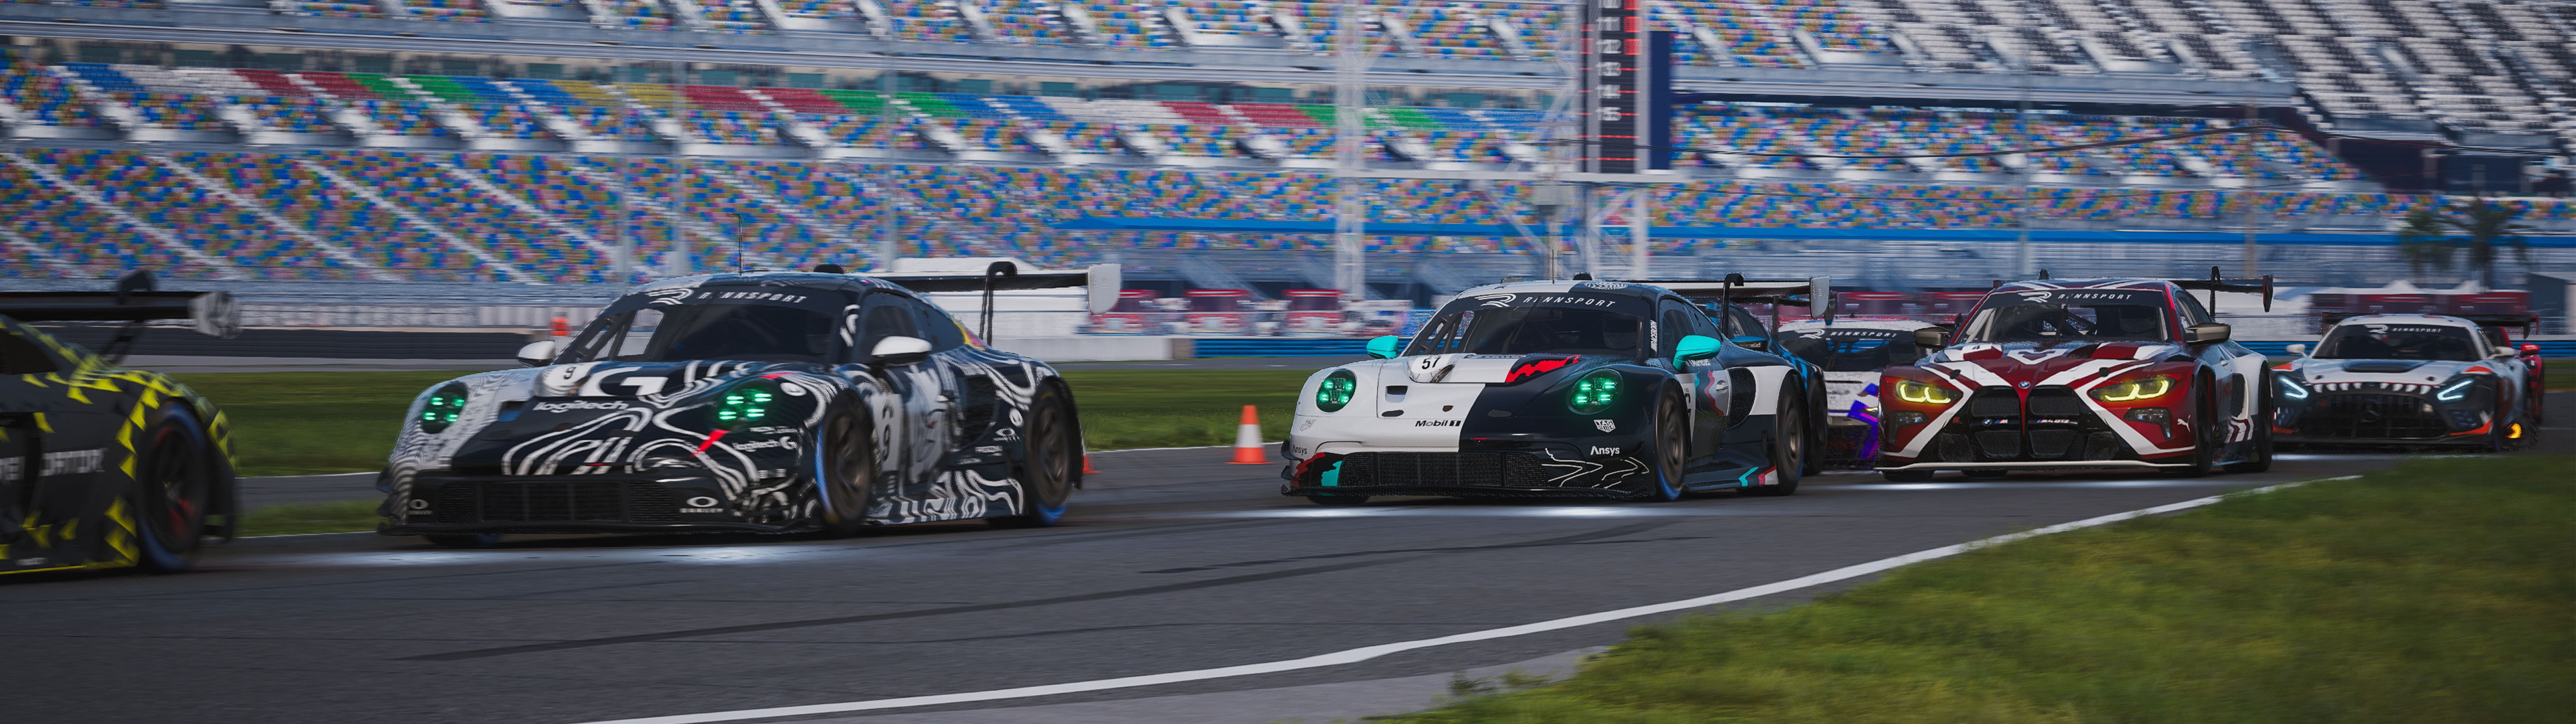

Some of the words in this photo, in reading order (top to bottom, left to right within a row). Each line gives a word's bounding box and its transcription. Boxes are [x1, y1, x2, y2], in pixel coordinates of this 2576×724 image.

[1422, 356, 1441, 369] 57
[564, 367, 576, 379] 9
[532, 400, 629, 413] logitech
[1292, 444, 1307, 456] Ansys
[1590, 446, 1620, 456] Ansys
